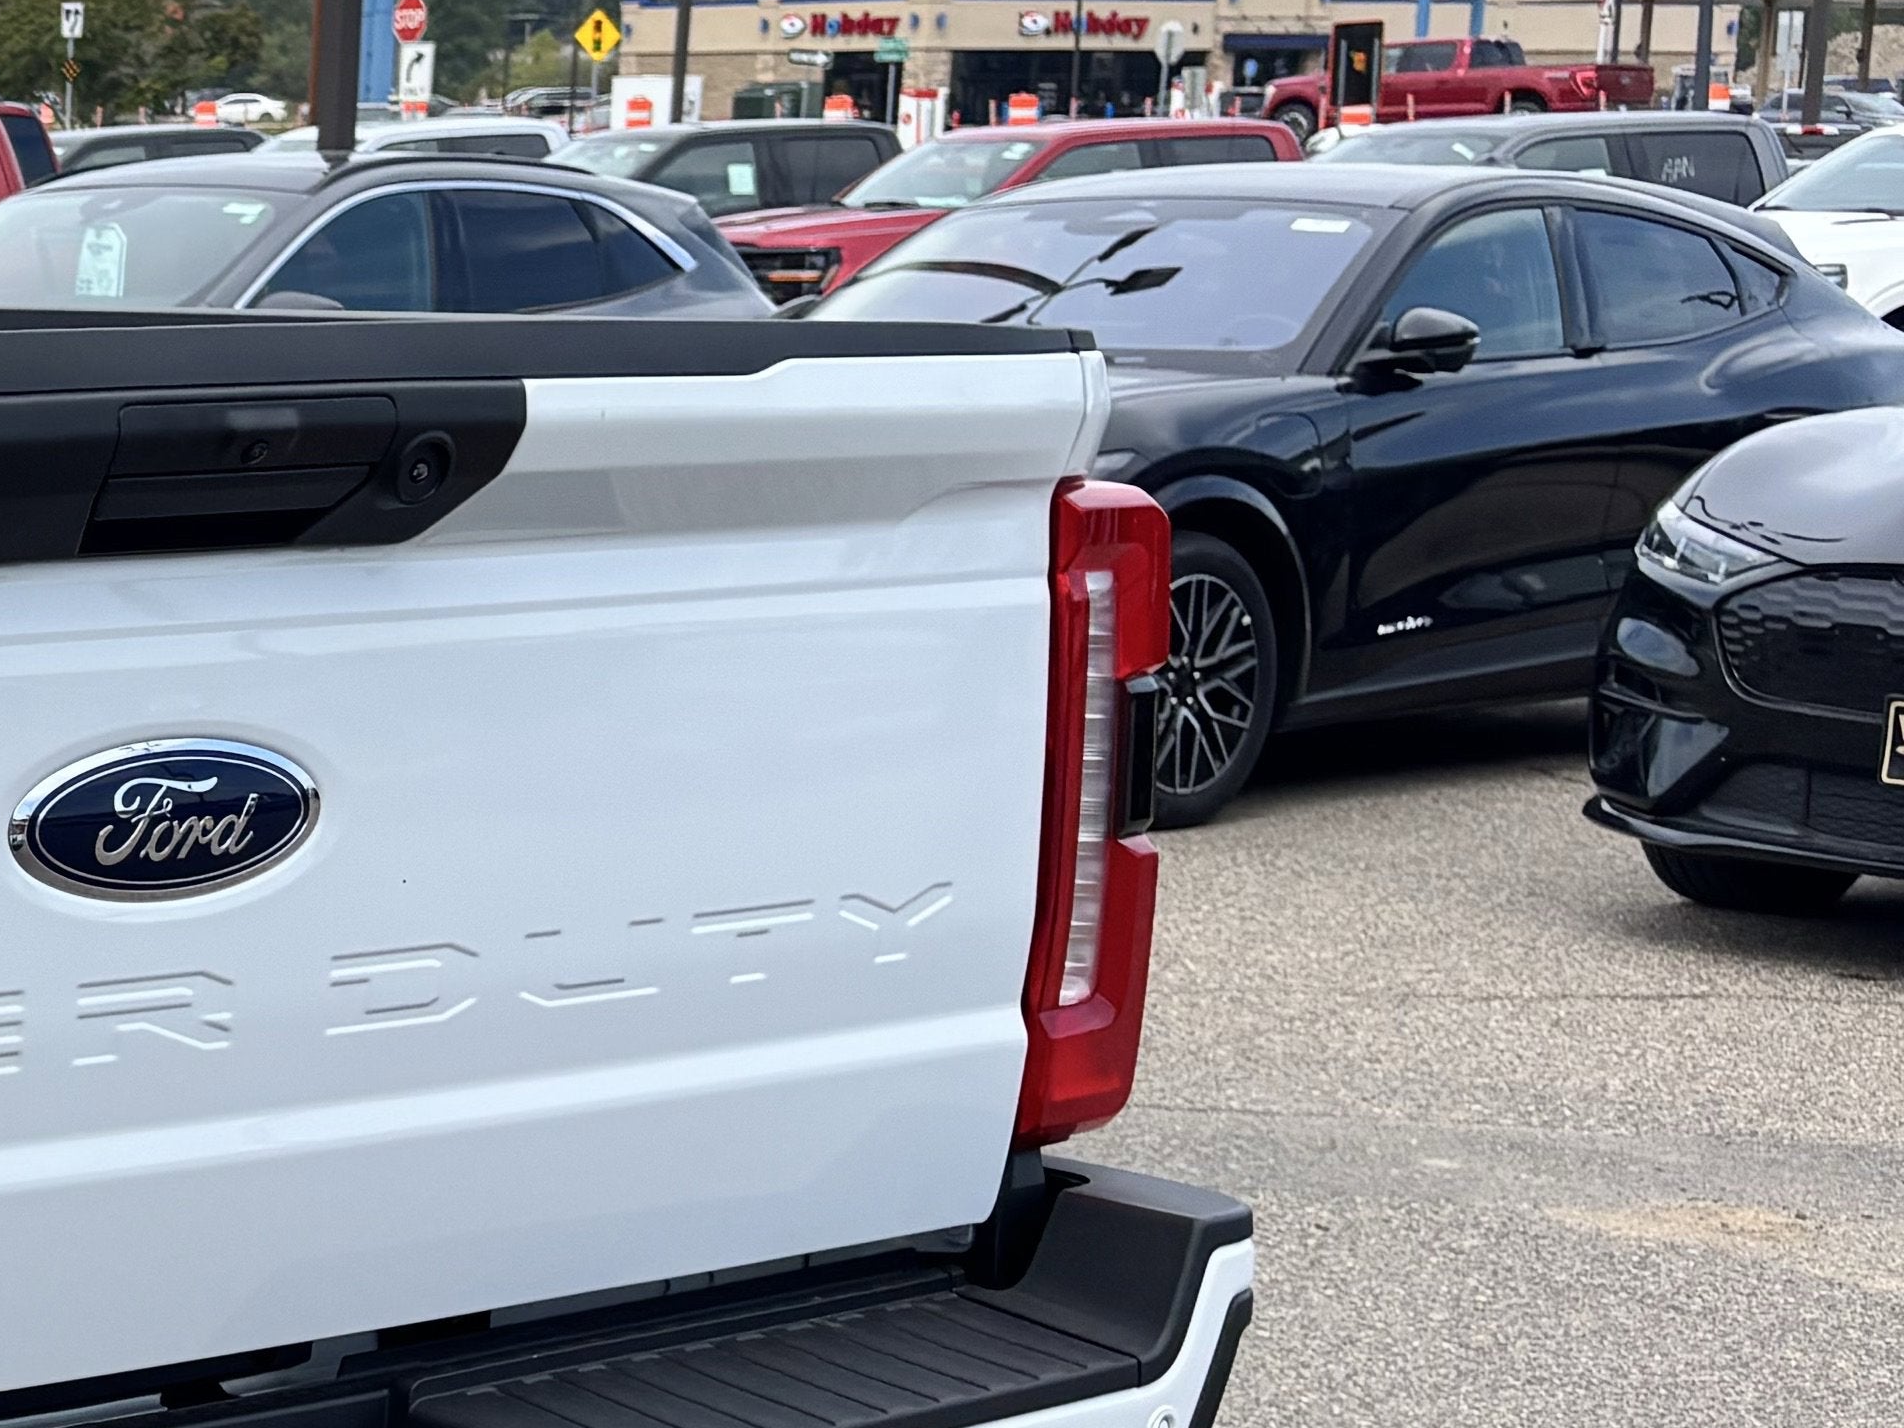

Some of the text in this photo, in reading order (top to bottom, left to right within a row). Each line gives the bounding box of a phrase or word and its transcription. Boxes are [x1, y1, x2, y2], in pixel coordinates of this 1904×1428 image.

[394, 8, 425, 29] STOP
[95, 776, 261, 866] Ford
[325, 882, 953, 1035] DUTY
